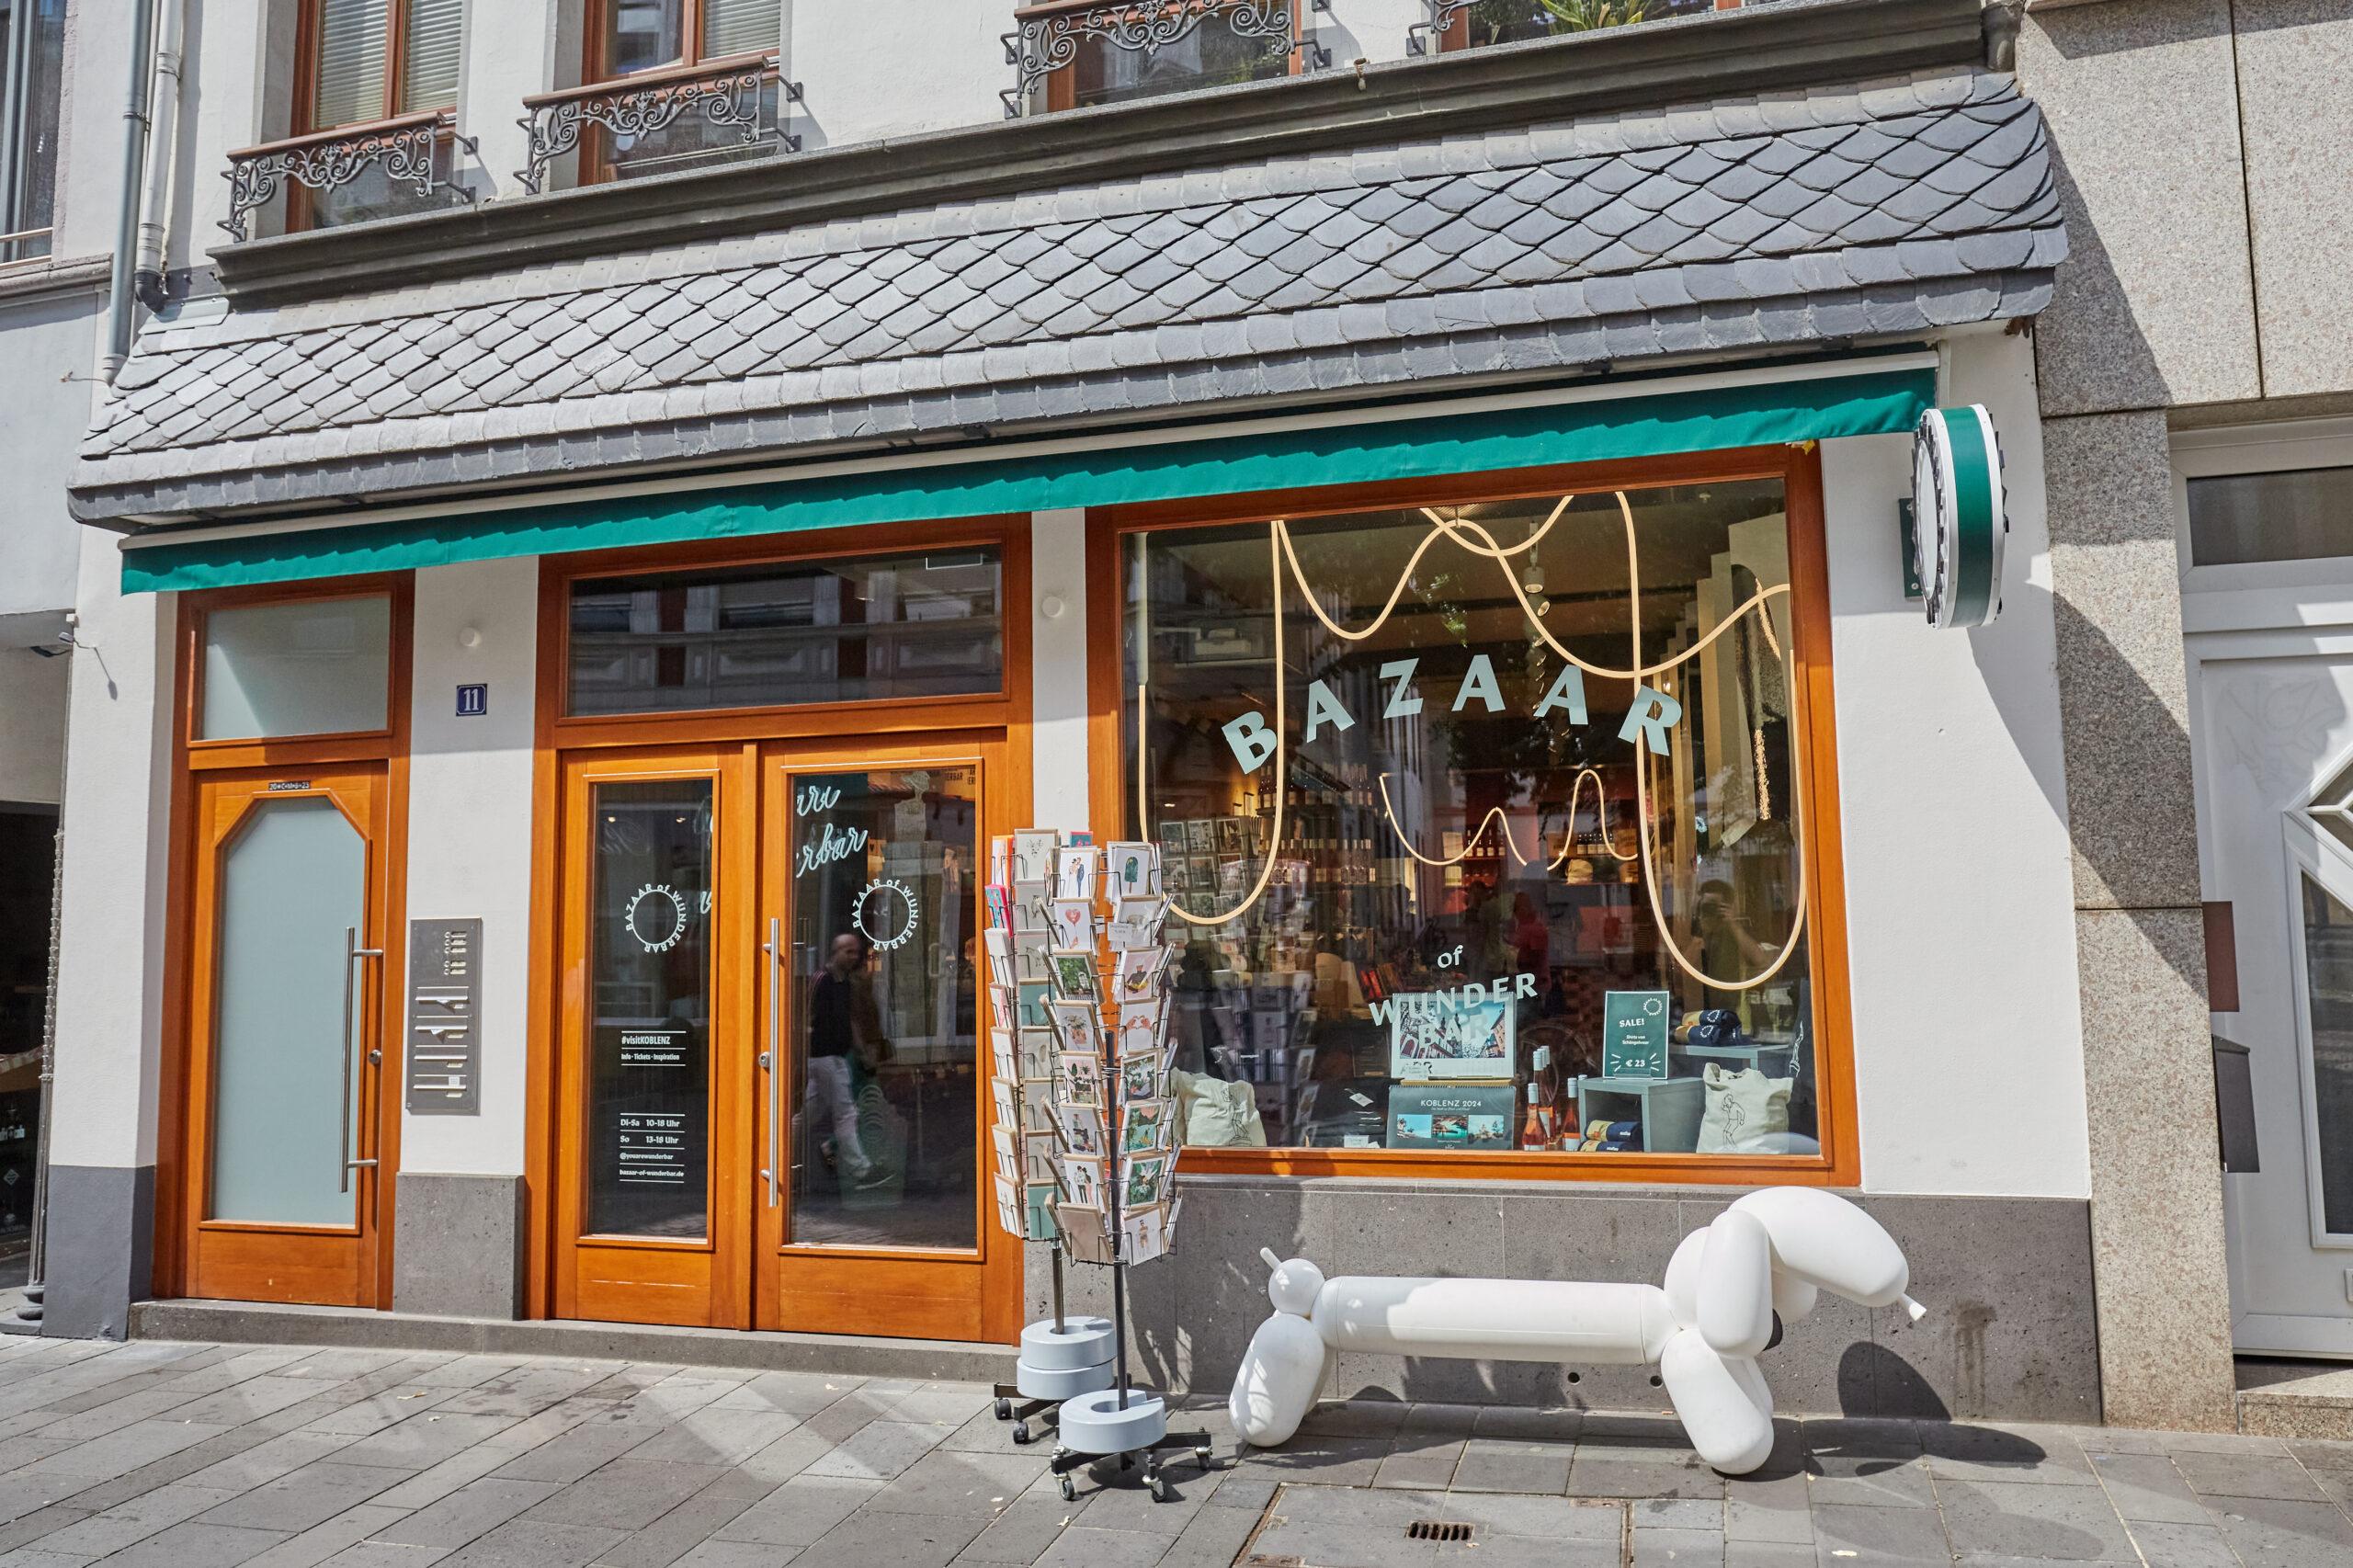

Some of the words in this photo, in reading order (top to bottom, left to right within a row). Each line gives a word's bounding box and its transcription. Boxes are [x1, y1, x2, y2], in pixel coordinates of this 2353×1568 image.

[463, 688, 479, 711] 11
[1221, 653, 1682, 775] BAZAAR
[657, 884, 670, 892] of
[886, 879, 901, 888] of
[625, 883, 653, 931] BAZAAR
[851, 878, 881, 928] BAZAAR
[644, 890, 687, 953] WUNDERBAR
[873, 885, 919, 951] WUNDERBAR
[1437, 944, 1464, 969] of
[1368, 972, 1539, 1027] WUNDER
[1619, 1017, 1645, 1028] SALE!
[621, 1035, 671, 1045] #visitKOBLENZ
[620, 1052, 631, 1061] Info
[634, 1052, 652, 1061] Tickets
[1625, 1059, 1633, 1067] €
[1634, 1059, 1645, 1067] 23
[620, 1119, 641, 1127] Di-Sa
[665, 1119, 680, 1128] Uhr
[620, 1135, 631, 1143] So
[665, 1136, 679, 1144] Uhr
